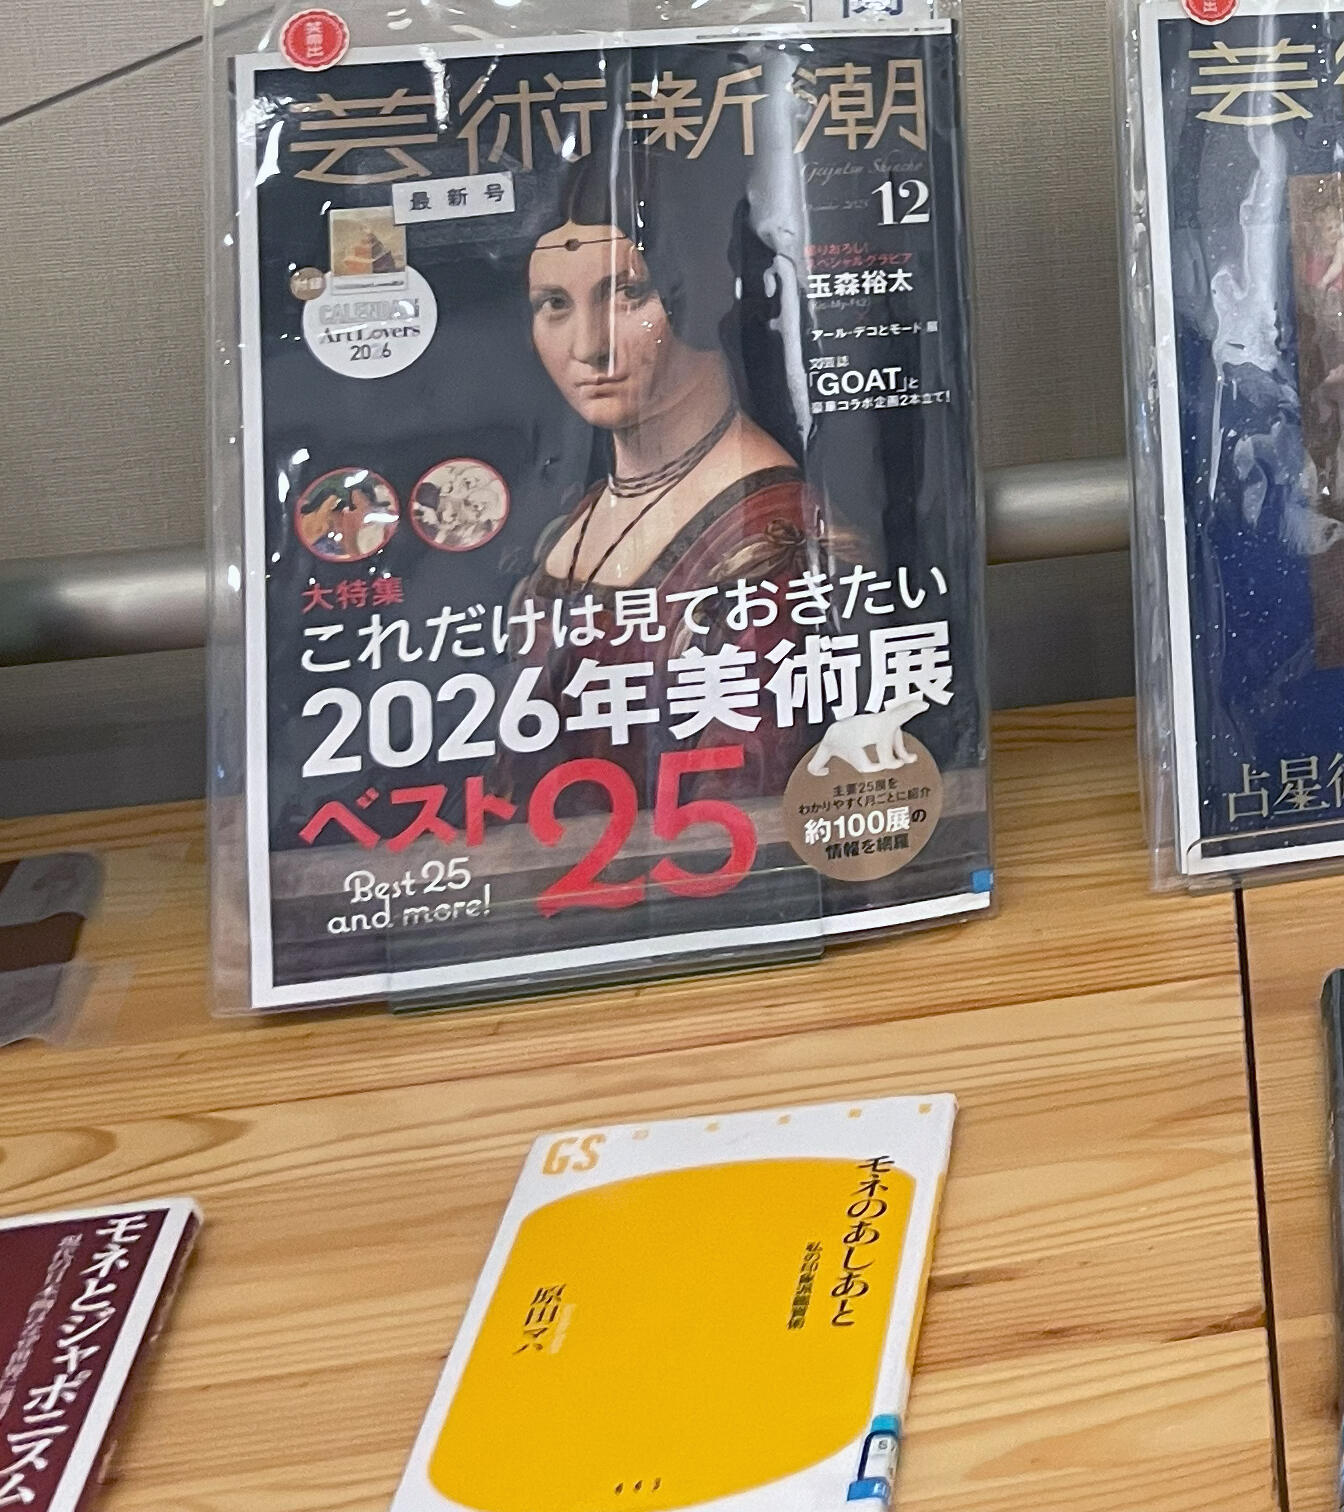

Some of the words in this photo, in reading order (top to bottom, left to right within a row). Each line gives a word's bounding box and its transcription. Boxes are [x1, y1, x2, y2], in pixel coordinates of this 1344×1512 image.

[290, 56, 929, 185] 芸術新潮
[410, 183, 505, 211] 最新号
[872, 179, 931, 226] 12
[807, 269, 913, 299] 玉森裕太
[301, 576, 405, 613] 大特集
[301, 564, 949, 674] これだけは見ておきたい
[301, 621, 954, 780] 2026年美術展
[798, 786, 931, 815] わかりやすく月ごとに紹介
[833, 777, 898, 798] 主要25展を
[804, 806, 927, 845] 約100展の
[825, 833, 910, 860] 情報を網羅
[344, 866, 417, 904] Best
[422, 859, 472, 895] 25
[327, 898, 393, 935] and
[402, 885, 492, 925] more!
[542, 1133, 606, 1176] GS
[830, 1155, 895, 1328] モネのあしあと
[511, 1283, 567, 1355] 原田マハ
[0, 1214, 148, 1506] モネとジャポニスム
